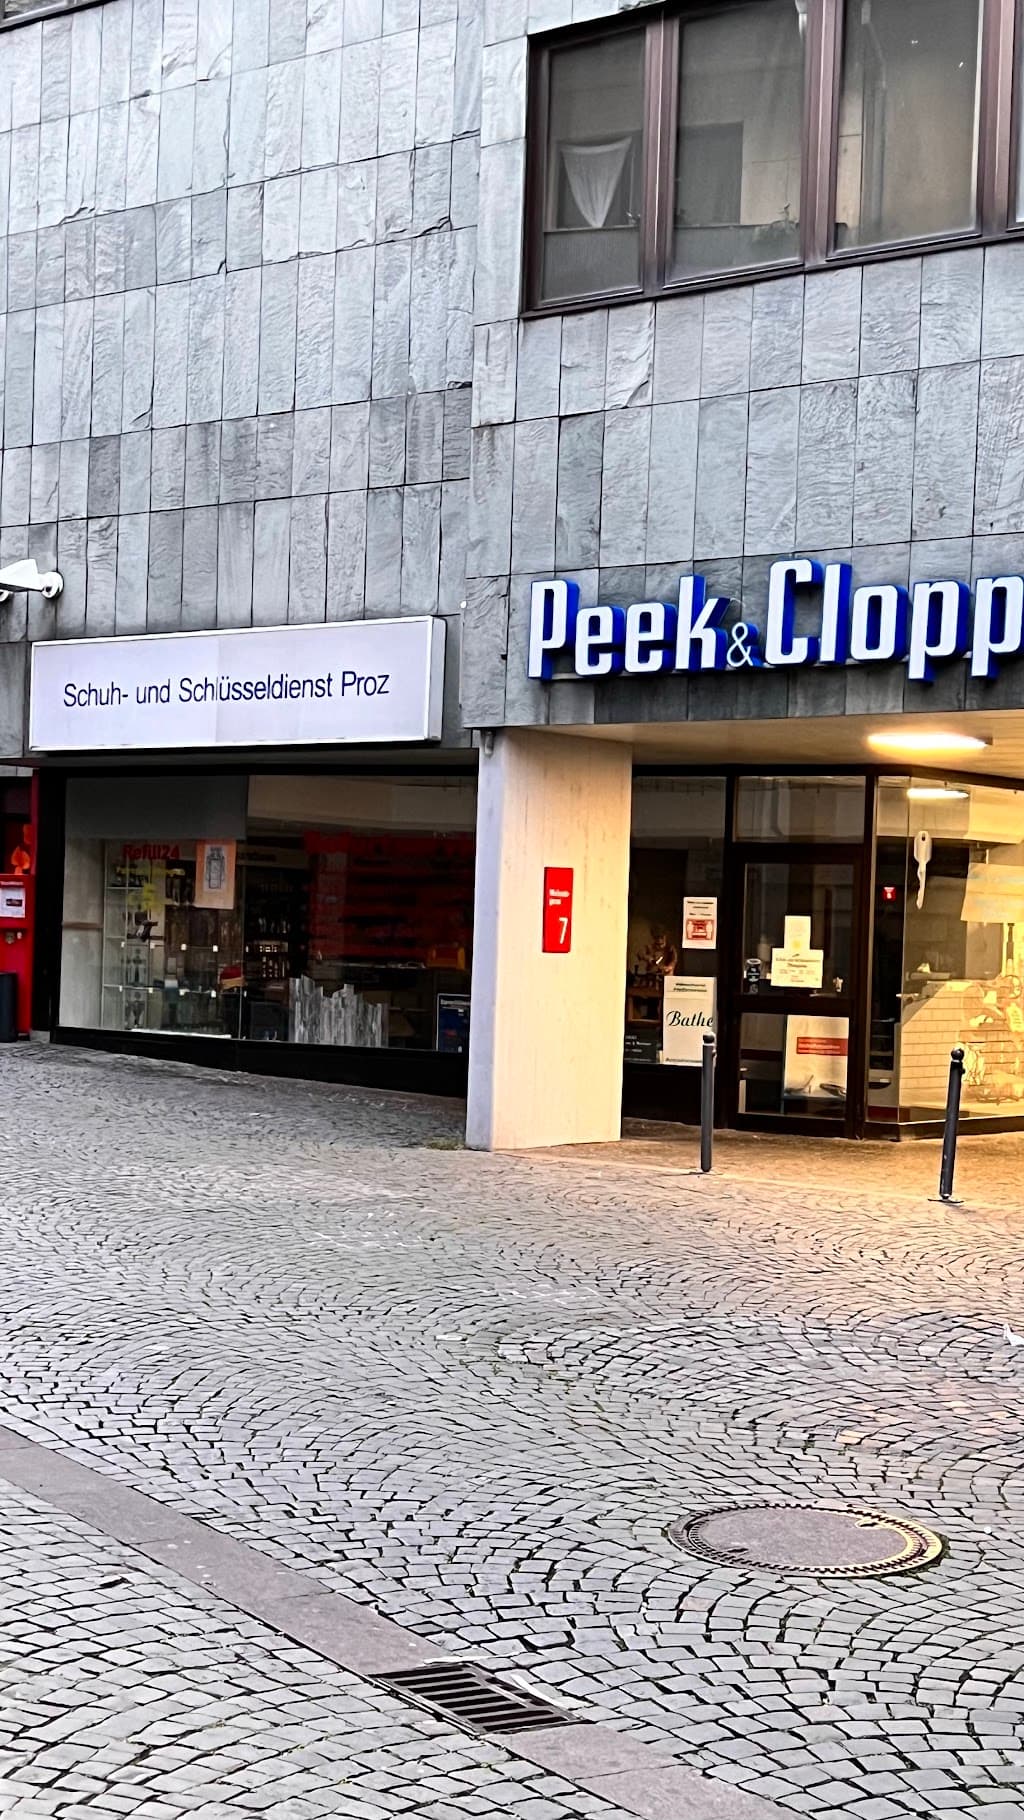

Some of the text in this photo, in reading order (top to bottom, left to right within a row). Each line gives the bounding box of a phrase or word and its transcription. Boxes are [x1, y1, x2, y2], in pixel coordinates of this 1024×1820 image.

[527, 558, 1024, 682] Peek & Clopp
[63, 670, 390, 708] Schuh- und Schlüsseldienst Proz
[558, 916, 569, 944] 7
